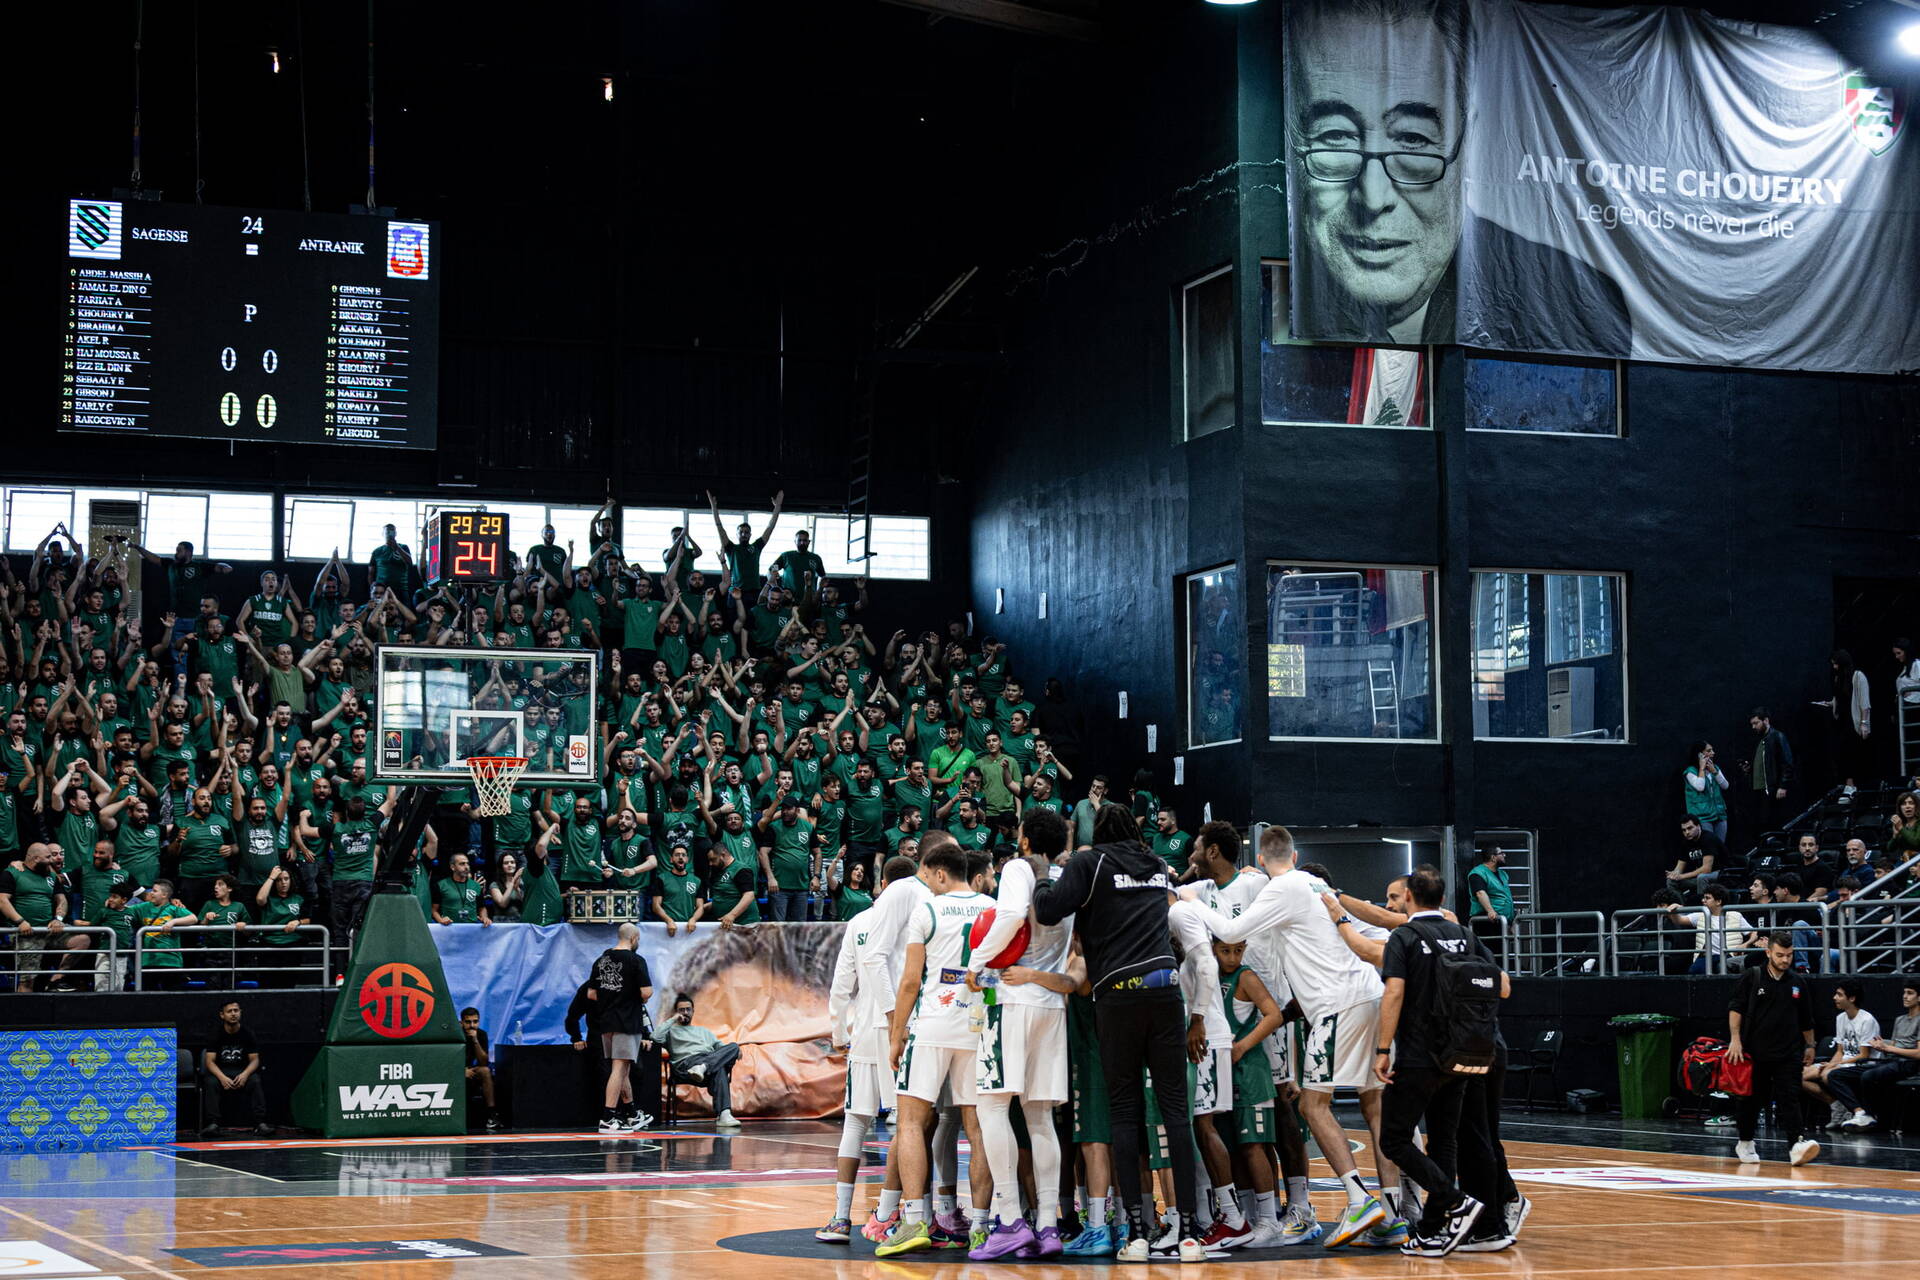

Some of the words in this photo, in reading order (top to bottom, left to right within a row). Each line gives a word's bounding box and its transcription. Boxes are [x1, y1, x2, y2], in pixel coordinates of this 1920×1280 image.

[1517, 154, 1666, 194] ANTOINE
[1677, 169, 1848, 205] CHOUEIRY
[1576, 196, 1675, 230] Legends
[1684, 212, 1750, 236] never
[1759, 212, 1796, 239] die
[241, 216, 264, 234] 24
[132, 227, 189, 243] SAGESSE
[299, 239, 365, 254] ANTRANIK
[110, 271, 143, 280] MASSIH
[144, 273, 152, 281] A
[78, 282, 108, 292] JAMAL
[109, 284, 121, 292] EL
[122, 285, 139, 293] DIN
[139, 286, 147, 294] O
[339, 285, 374, 295] GHOSEN
[70, 295, 75, 303] 2
[78, 295, 114, 305] FARHAT
[115, 298, 123, 306] A
[339, 298, 375, 308] HARVEY
[375, 301, 383, 309] C
[69, 308, 75, 316] 3
[244, 304, 257, 322] P
[331, 311, 337, 319] 2
[339, 311, 374, 321] BRUNER
[374, 313, 379, 321] J
[69, 321, 75, 329] 9
[77, 322, 116, 331] IBRAHIM
[339, 324, 375, 334] AKKAWI
[77, 335, 101, 344] AKEL
[102, 336, 109, 345] R
[339, 337, 380, 347] COLEMAN
[65, 348, 74, 356] 13
[76, 348, 93, 357] HAJ
[94, 350, 132, 359] MOUSSA
[133, 352, 140, 360] R
[338, 350, 362, 359] ALAA
[363, 351, 379, 360] DIN
[380, 352, 385, 360] S
[221, 347, 237, 372] 0
[262, 349, 278, 374] 0
[65, 361, 73, 369] 14
[76, 361, 93, 370] EZZ
[94, 363, 106, 371] EL
[107, 363, 123, 372] DIN
[124, 364, 132, 373] K
[338, 363, 374, 373] KHOURY
[326, 376, 335, 384] 22
[338, 376, 384, 386] GHANTOUS
[385, 379, 392, 387] Y
[63, 388, 73, 396] 22
[75, 388, 109, 397] GIBSON
[110, 390, 114, 398] J
[337, 389, 372, 399] NAKHLE
[63, 401, 72, 409] 23
[75, 401, 105, 411] EARLY
[106, 403, 113, 411] C
[220, 392, 241, 427] 0
[256, 393, 277, 428] 0
[372, 404, 380, 412] A
[75, 415, 127, 425] RAKOCEVIC
[128, 418, 135, 426] N
[337, 415, 372, 424] FAKHRY
[373, 417, 379, 425] P
[325, 428, 334, 436] 77
[337, 428, 373, 438] LAHOUD
[374, 430, 380, 438] L
[450, 516, 472, 535] 29
[479, 517, 502, 535] 29
[454, 541, 496, 575] 24
[380, 1063, 413, 1080] FIBA
[339, 1083, 454, 1111] WASL
